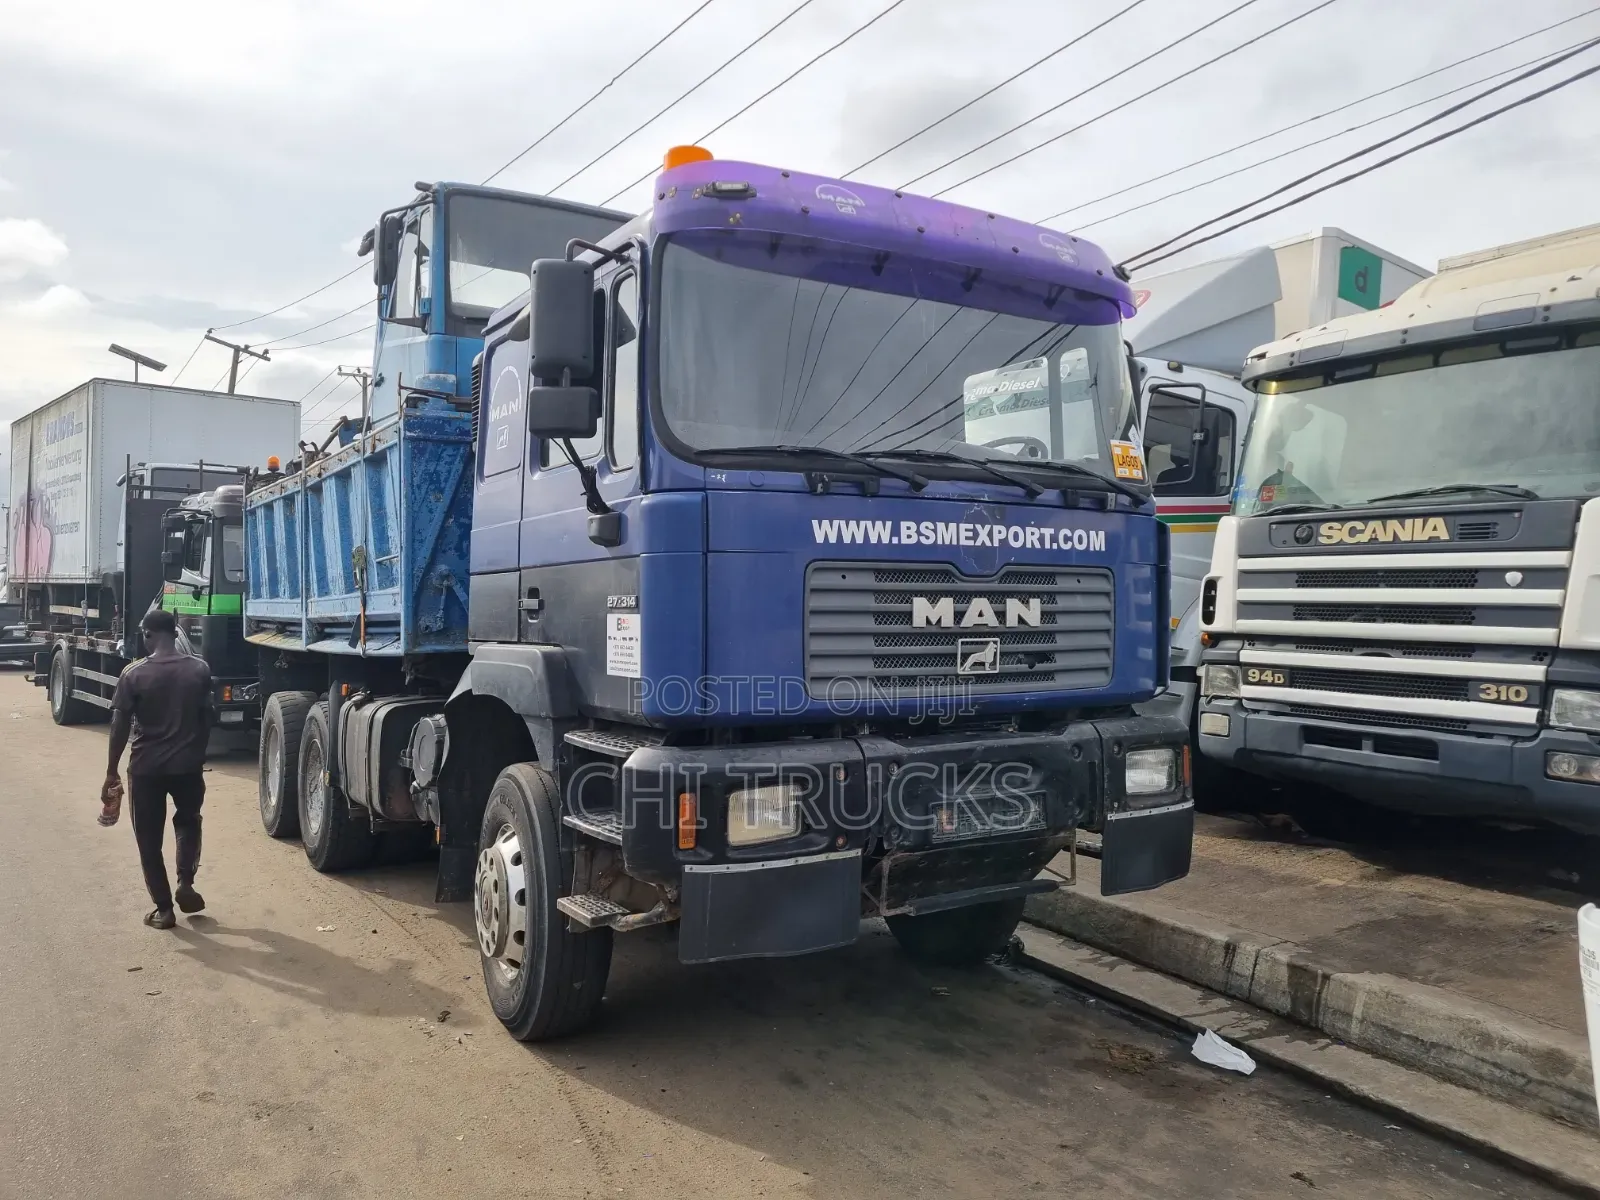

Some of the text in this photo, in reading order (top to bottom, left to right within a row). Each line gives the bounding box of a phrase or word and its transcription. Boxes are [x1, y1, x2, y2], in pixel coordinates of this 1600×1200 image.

[1354, 265, 1368, 294] d
[998, 376, 1041, 393] Diesel
[490, 398, 520, 422] MAN
[1116, 454, 1139, 469] LAGOS
[811, 519, 1106, 552] WWW.BSMEXPORT.COM
[1317, 517, 1450, 545] SCANIA
[912, 597, 1041, 628] MAN
[1247, 668, 1285, 684] 94D
[1478, 683, 1529, 702] 310
